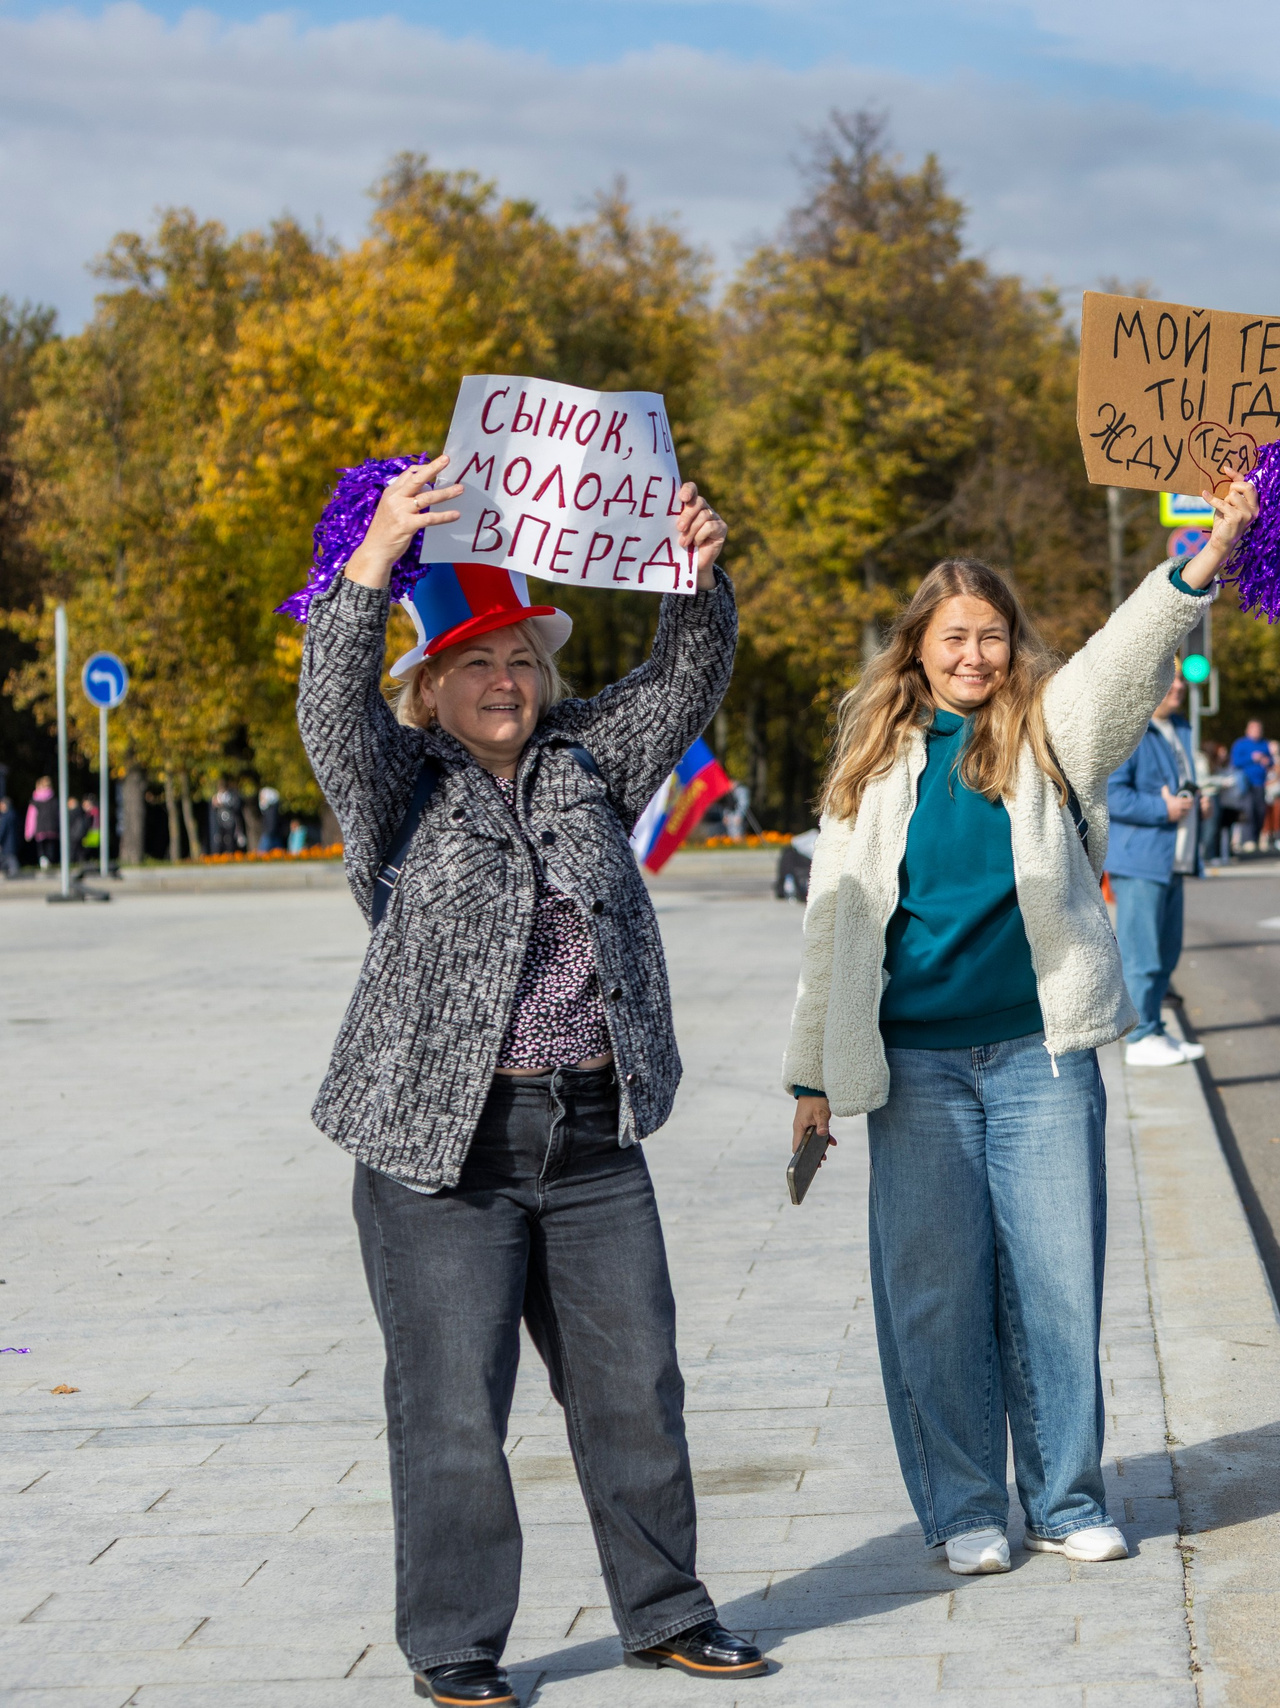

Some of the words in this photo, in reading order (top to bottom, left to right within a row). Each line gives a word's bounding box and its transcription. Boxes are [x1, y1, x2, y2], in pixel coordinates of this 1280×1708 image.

[1113, 309, 1211, 374] МОЙ
[480, 386, 633, 460] СЫНОК,
[1144, 378, 1206, 421] ТЫ
[1089, 403, 1184, 481] ЖДУ
[1195, 428, 1250, 475] ТЕБЯ
[471, 508, 695, 590] ВПЕРЕД!
